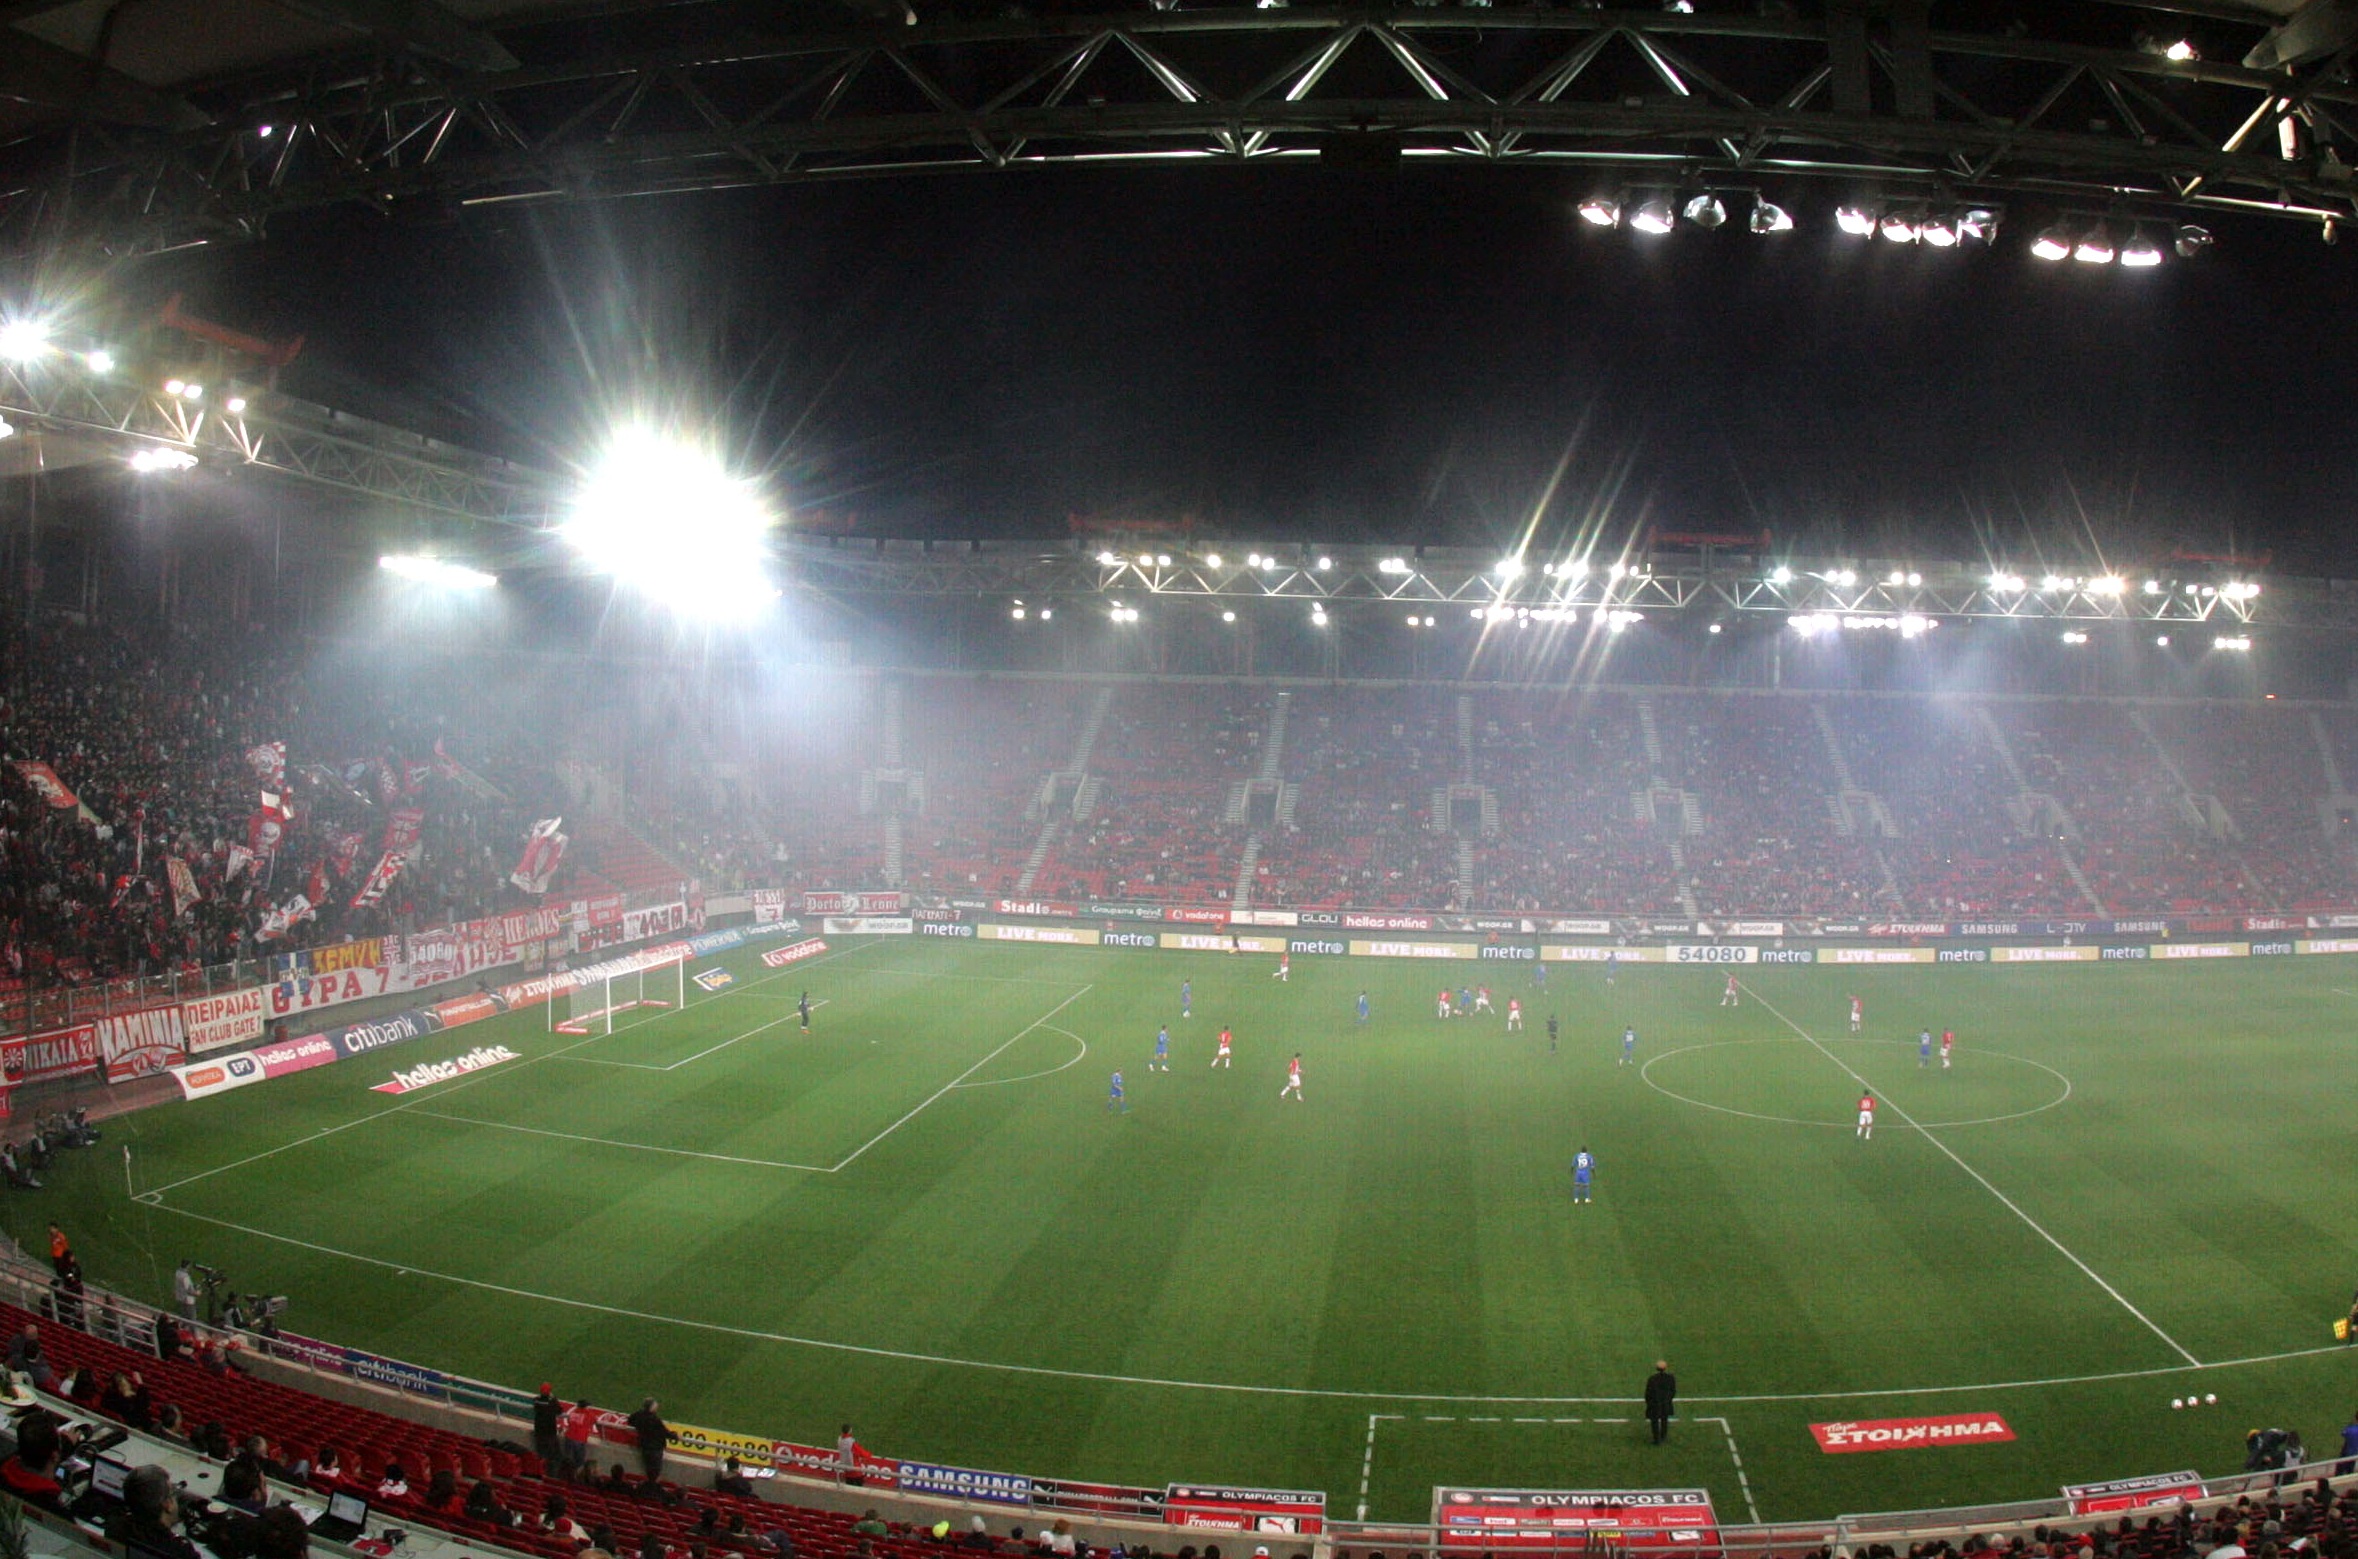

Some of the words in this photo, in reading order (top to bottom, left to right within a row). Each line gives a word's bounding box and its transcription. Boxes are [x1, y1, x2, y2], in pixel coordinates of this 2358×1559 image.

[1346, 915, 1386, 928] hellas
[1388, 917, 1428, 929] online
[1961, 923, 2018, 935] SAMSUNG
[923, 923, 972, 937] metro
[996, 926, 1035, 940] LIVE
[1104, 932, 1155, 947] metro
[1180, 935, 1221, 948] LIVE
[1291, 939, 1344, 954] metro
[1370, 942, 1412, 956] LIVE
[1482, 945, 1535, 960] metro
[1561, 948, 1600, 960] LIVE
[1678, 946, 1747, 962] 54080
[2102, 946, 2146, 960] metro
[2167, 946, 2199, 958] LIVE
[2252, 941, 2292, 955] metro
[2309, 941, 2338, 953] LIVE
[1762, 949, 1812, 963] metro
[1836, 950, 1875, 962] LIVE
[1939, 949, 1987, 963] metro
[2008, 949, 2043, 961] LIVE
[375, 966, 390, 993] 7
[186, 989, 261, 1025] ΠΕΙΡΑΙΑΣ
[208, 1021, 232, 1043] CLUB
[233, 1017, 256, 1036] GATE
[344, 1014, 419, 1053] citibank
[392, 1059, 458, 1089] hellas
[458, 1044, 513, 1070] online
[1577, 1158, 1589, 1169] 19
[357, 1359, 428, 1392] citibank
[1826, 1420, 2005, 1445] ΣΤΟΙΧΗΜΑ
[900, 1464, 1028, 1500] SAMSUNG
[1222, 1490, 1298, 1503] OLYMPIACOS
[1300, 1494, 1317, 1503] FC
[1531, 1494, 1666, 1506] OLYMPIACOS
[1672, 1493, 1700, 1504] FC
